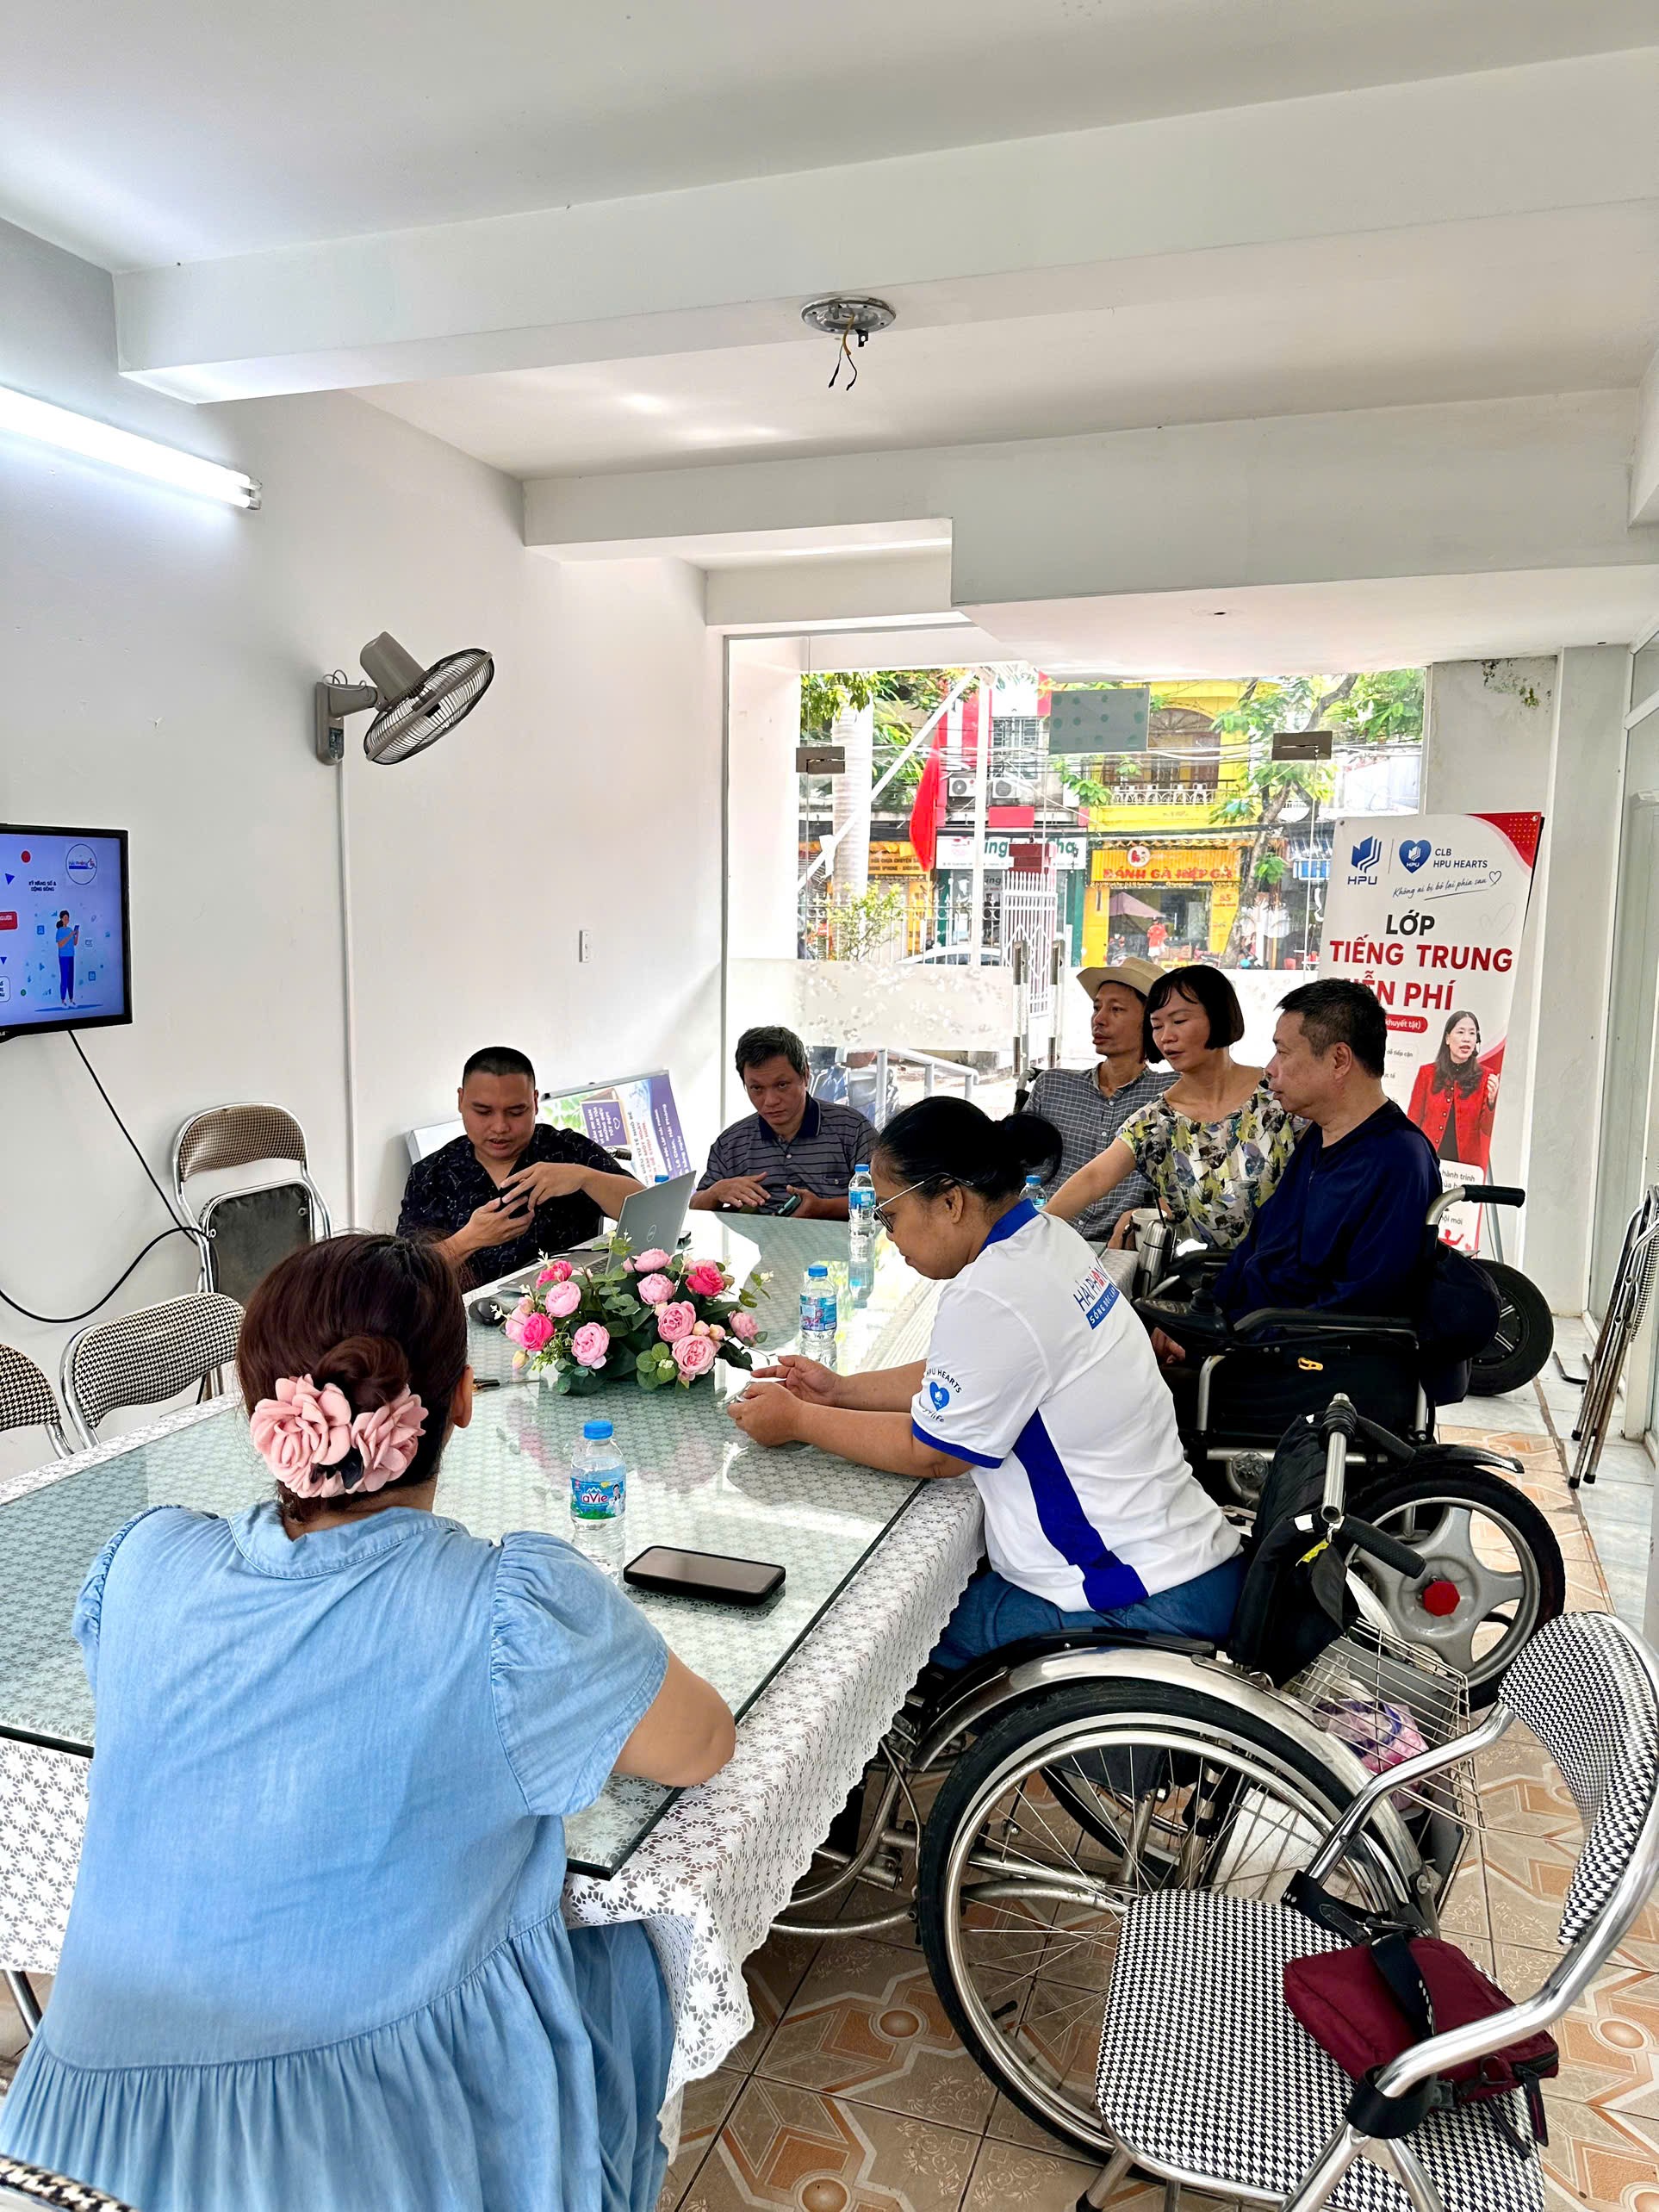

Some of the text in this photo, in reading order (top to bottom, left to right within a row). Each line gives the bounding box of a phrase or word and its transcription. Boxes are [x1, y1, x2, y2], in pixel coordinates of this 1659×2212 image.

[985, 838, 1008, 857] ing
[1434, 848, 1451, 856] CLB
[1432, 860, 1488, 868] HPU HEARTS
[1347, 876, 1378, 885] HPU
[1392, 887, 1415, 898] Không
[1385, 910, 1435, 935] LỚP
[1330, 935, 1513, 972] TIẾNG TRUNG
[1403, 979, 1457, 1010] PHÍ
[1442, 1170, 1458, 1179] hành
[937, 1369, 962, 1394] HEARTS
